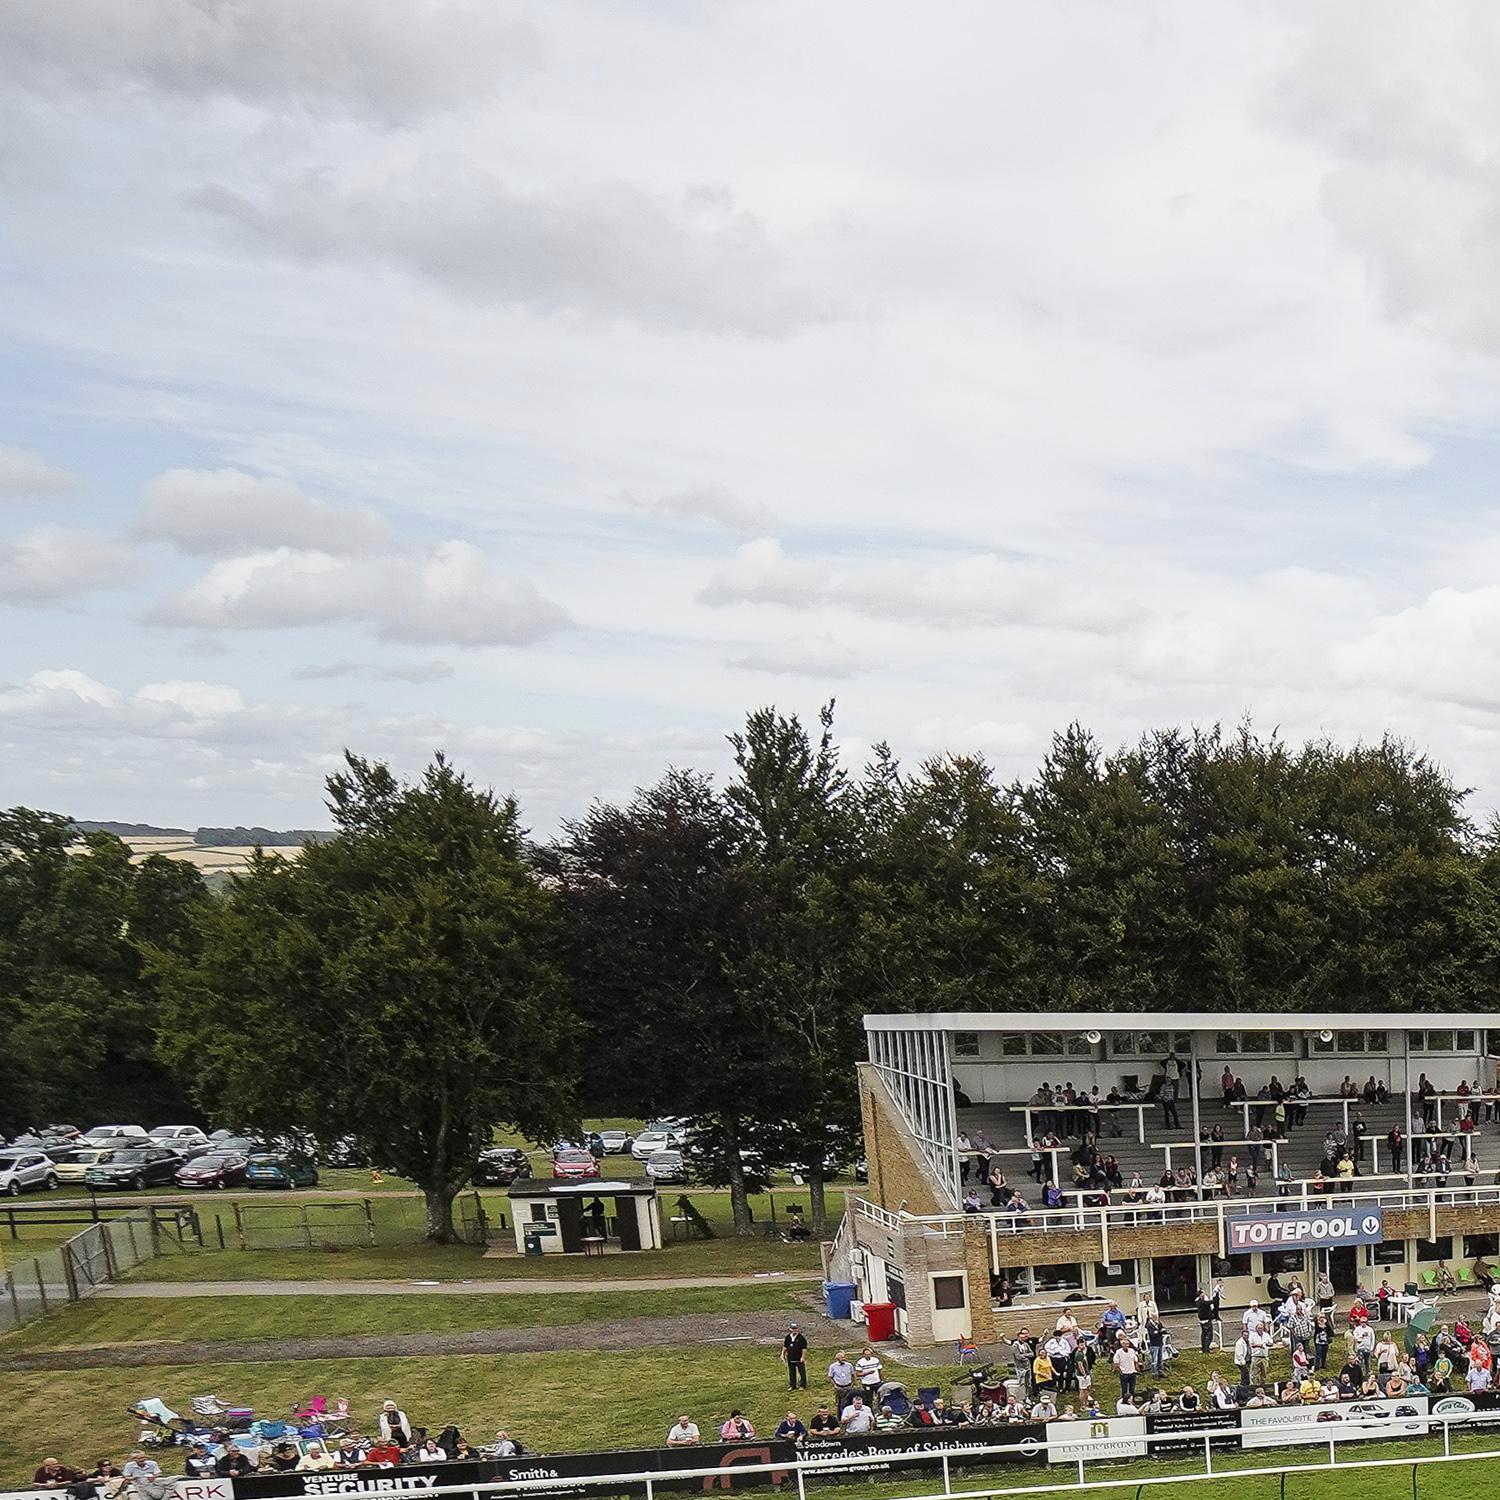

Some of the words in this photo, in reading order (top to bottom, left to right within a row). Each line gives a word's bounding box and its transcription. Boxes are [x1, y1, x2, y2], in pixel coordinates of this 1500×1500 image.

[1235, 1218, 1358, 1244] TOTEPOOL
[1250, 1418, 1267, 1426] THE
[1267, 1415, 1313, 1425] FAVOURITE
[804, 1439, 842, 1449] Sandown
[795, 1446, 902, 1462] Mercedes-Benz
[905, 1442, 921, 1454] of
[923, 1440, 989, 1453] Salisbury
[302, 1473, 359, 1484] VENTURE
[509, 1468, 549, 1480] Smith
[549, 1469, 559, 1478] &
[304, 1475, 438, 1497] SECURITY
